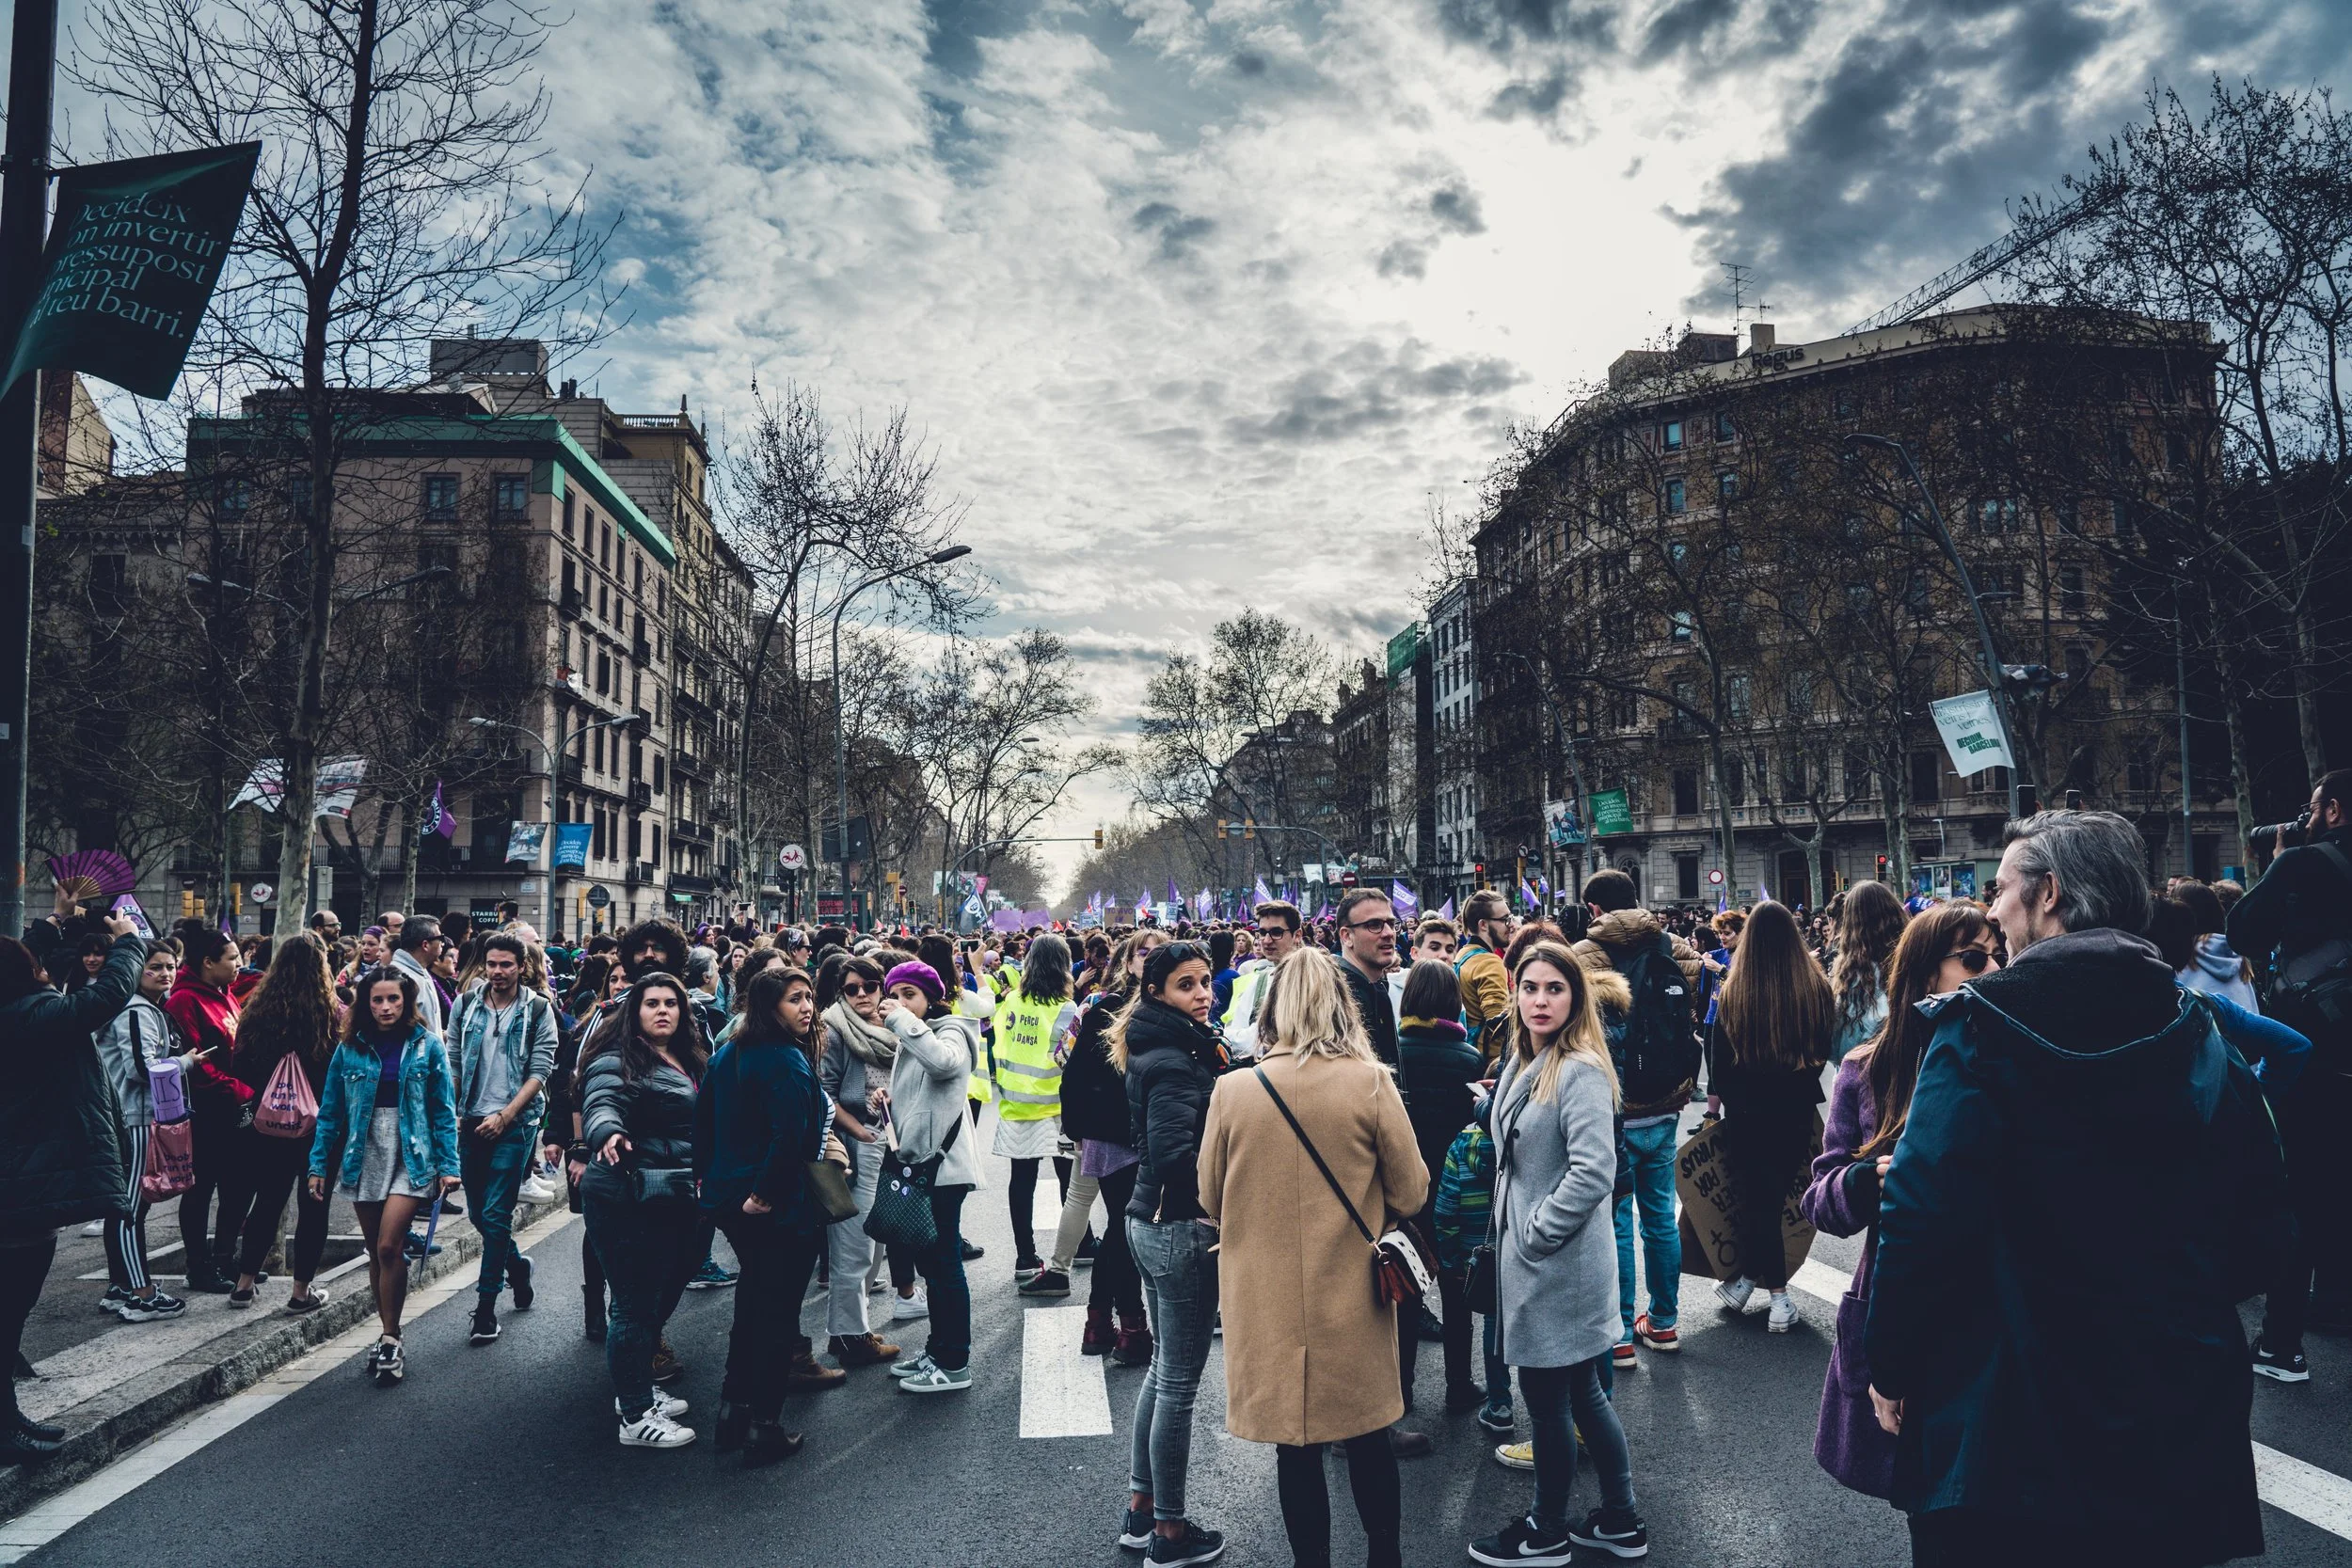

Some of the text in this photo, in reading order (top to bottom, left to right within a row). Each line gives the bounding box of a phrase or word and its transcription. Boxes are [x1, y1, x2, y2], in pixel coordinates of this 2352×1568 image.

[103, 217, 221, 258] invertir
[96, 286, 185, 339] barri.
[1751, 348, 1804, 372] Regus
[1020, 1015, 1040, 1026] PERCU
[1016, 1033, 1038, 1046] DANSA
